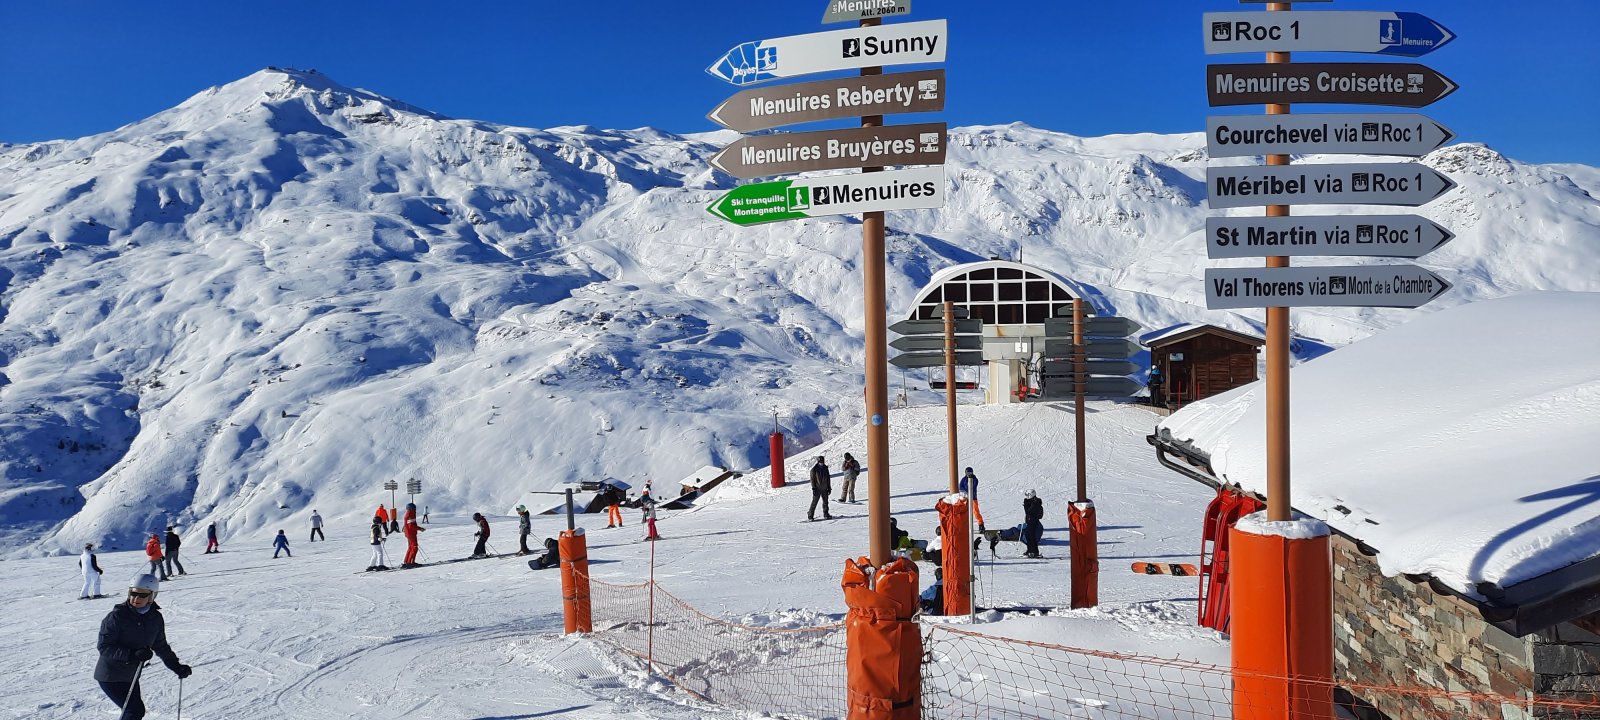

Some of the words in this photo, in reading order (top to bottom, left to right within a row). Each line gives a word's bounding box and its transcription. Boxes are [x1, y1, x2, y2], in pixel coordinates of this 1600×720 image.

[838, 0, 896, 13] Menuires
[877, 6, 896, 15] 2060
[1235, 21, 1281, 41] Roc
[1290, 20, 1299, 40] 1
[864, 35, 938, 55] Sunny
[1403, 37, 1433, 46] Menuires
[1216, 72, 1310, 93] Menuires
[1317, 71, 1404, 92] Croisette
[750, 92, 830, 117] Menuires
[837, 83, 915, 107] Reberty
[1216, 124, 1328, 145] Courchevel
[1334, 125, 1358, 143] via
[1382, 123, 1411, 142] Roc
[1416, 123, 1423, 142] 1
[741, 143, 821, 165] Menuires
[827, 136, 915, 162] Bruyères
[833, 180, 935, 204] Menuires
[1216, 175, 1305, 196] Méribel
[1314, 174, 1342, 193] via
[1373, 173, 1408, 192] Roc
[1414, 173, 1422, 191] 1
[731, 198, 744, 206] Ski
[745, 195, 785, 205] tranquille
[734, 206, 786, 216] Montagnette
[1216, 227, 1239, 246] St
[1247, 226, 1317, 246] Martin
[1324, 226, 1350, 245] via
[1377, 225, 1409, 244] Roc
[1414, 225, 1421, 243] 1
[1213, 278, 1238, 297] Val
[1243, 278, 1304, 297] Thorens
[1308, 277, 1327, 295] via
[1348, 276, 1373, 295] Mont
[1374, 281, 1383, 294] de
[1384, 281, 1391, 294] la
[1393, 275, 1433, 294] Chambre
